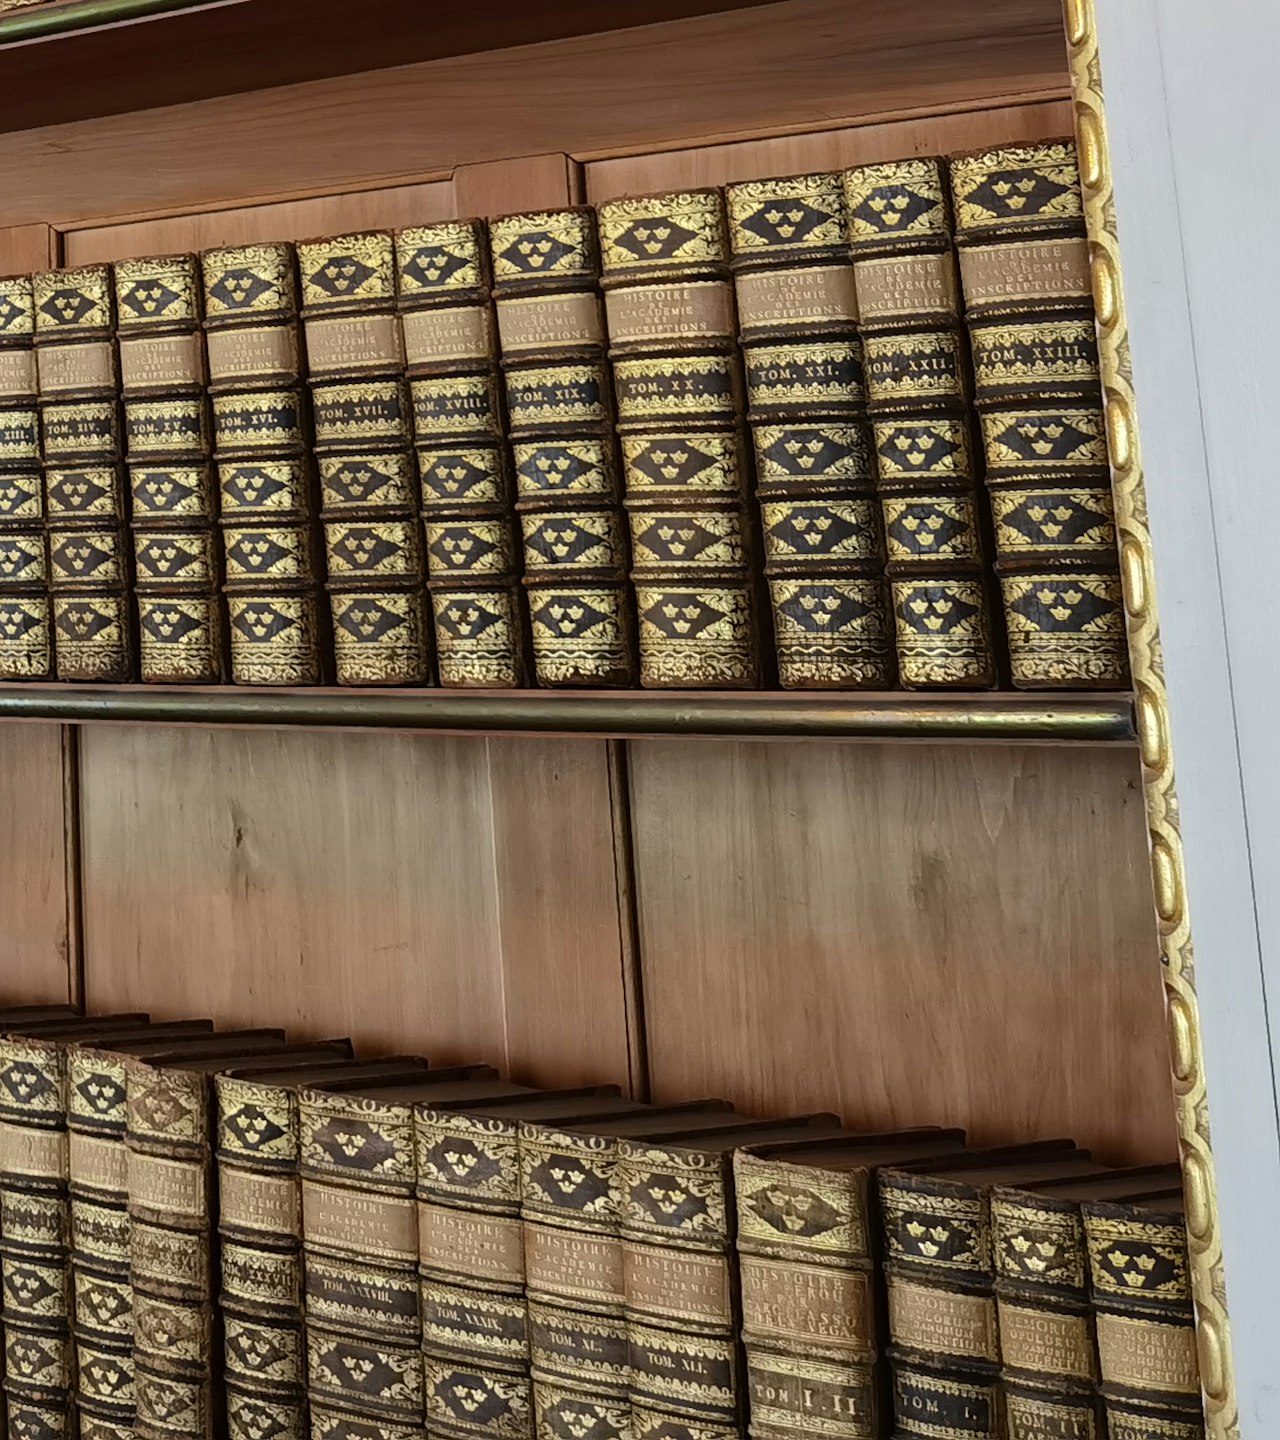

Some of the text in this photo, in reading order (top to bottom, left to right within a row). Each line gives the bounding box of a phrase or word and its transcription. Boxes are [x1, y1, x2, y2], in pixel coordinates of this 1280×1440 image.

[979, 246, 1062, 262] HISTOIRE
[858, 262, 936, 279] HISTOIRE
[753, 274, 825, 287] HISTOIRE
[622, 289, 691, 303] HISTOIRE
[616, 322, 708, 336] INSCRIPTIONS
[980, 345, 1087, 363] TOM. XXIII.
[909, 358, 953, 371] XXII.
[758, 366, 839, 381] TOM. XXI.
[629, 379, 704, 394] TOM. XX.
[515, 388, 586, 402] TOM. XIX.
[414, 397, 488, 412] TOM. XVIII.
[220, 414, 278, 427] TOM. XVI.
[320, 406, 388, 420] TOM. XVII.
[4, 430, 29, 440] XIII.
[47, 422, 100, 435] TOM. XIV.
[132, 421, 187, 434] TOM. XV.
[320, 1192, 387, 1216] HISTOIRE
[433, 1214, 503, 1239] HISTOIRE
[537, 1233, 612, 1258] HISTOIRE
[635, 1254, 715, 1278] HISTOIRE
[322, 1279, 393, 1304] TOM. XXXVIII.
[437, 1306, 503, 1332] TOM. XXXIX.
[549, 1331, 603, 1352] TOM. XL.
[647, 1352, 708, 1374] TOM. XLI.
[754, 1384, 799, 1406] TOM.
[901, 1394, 977, 1420] TOM. I.
[1015, 1412, 1050, 1431] TOM.
